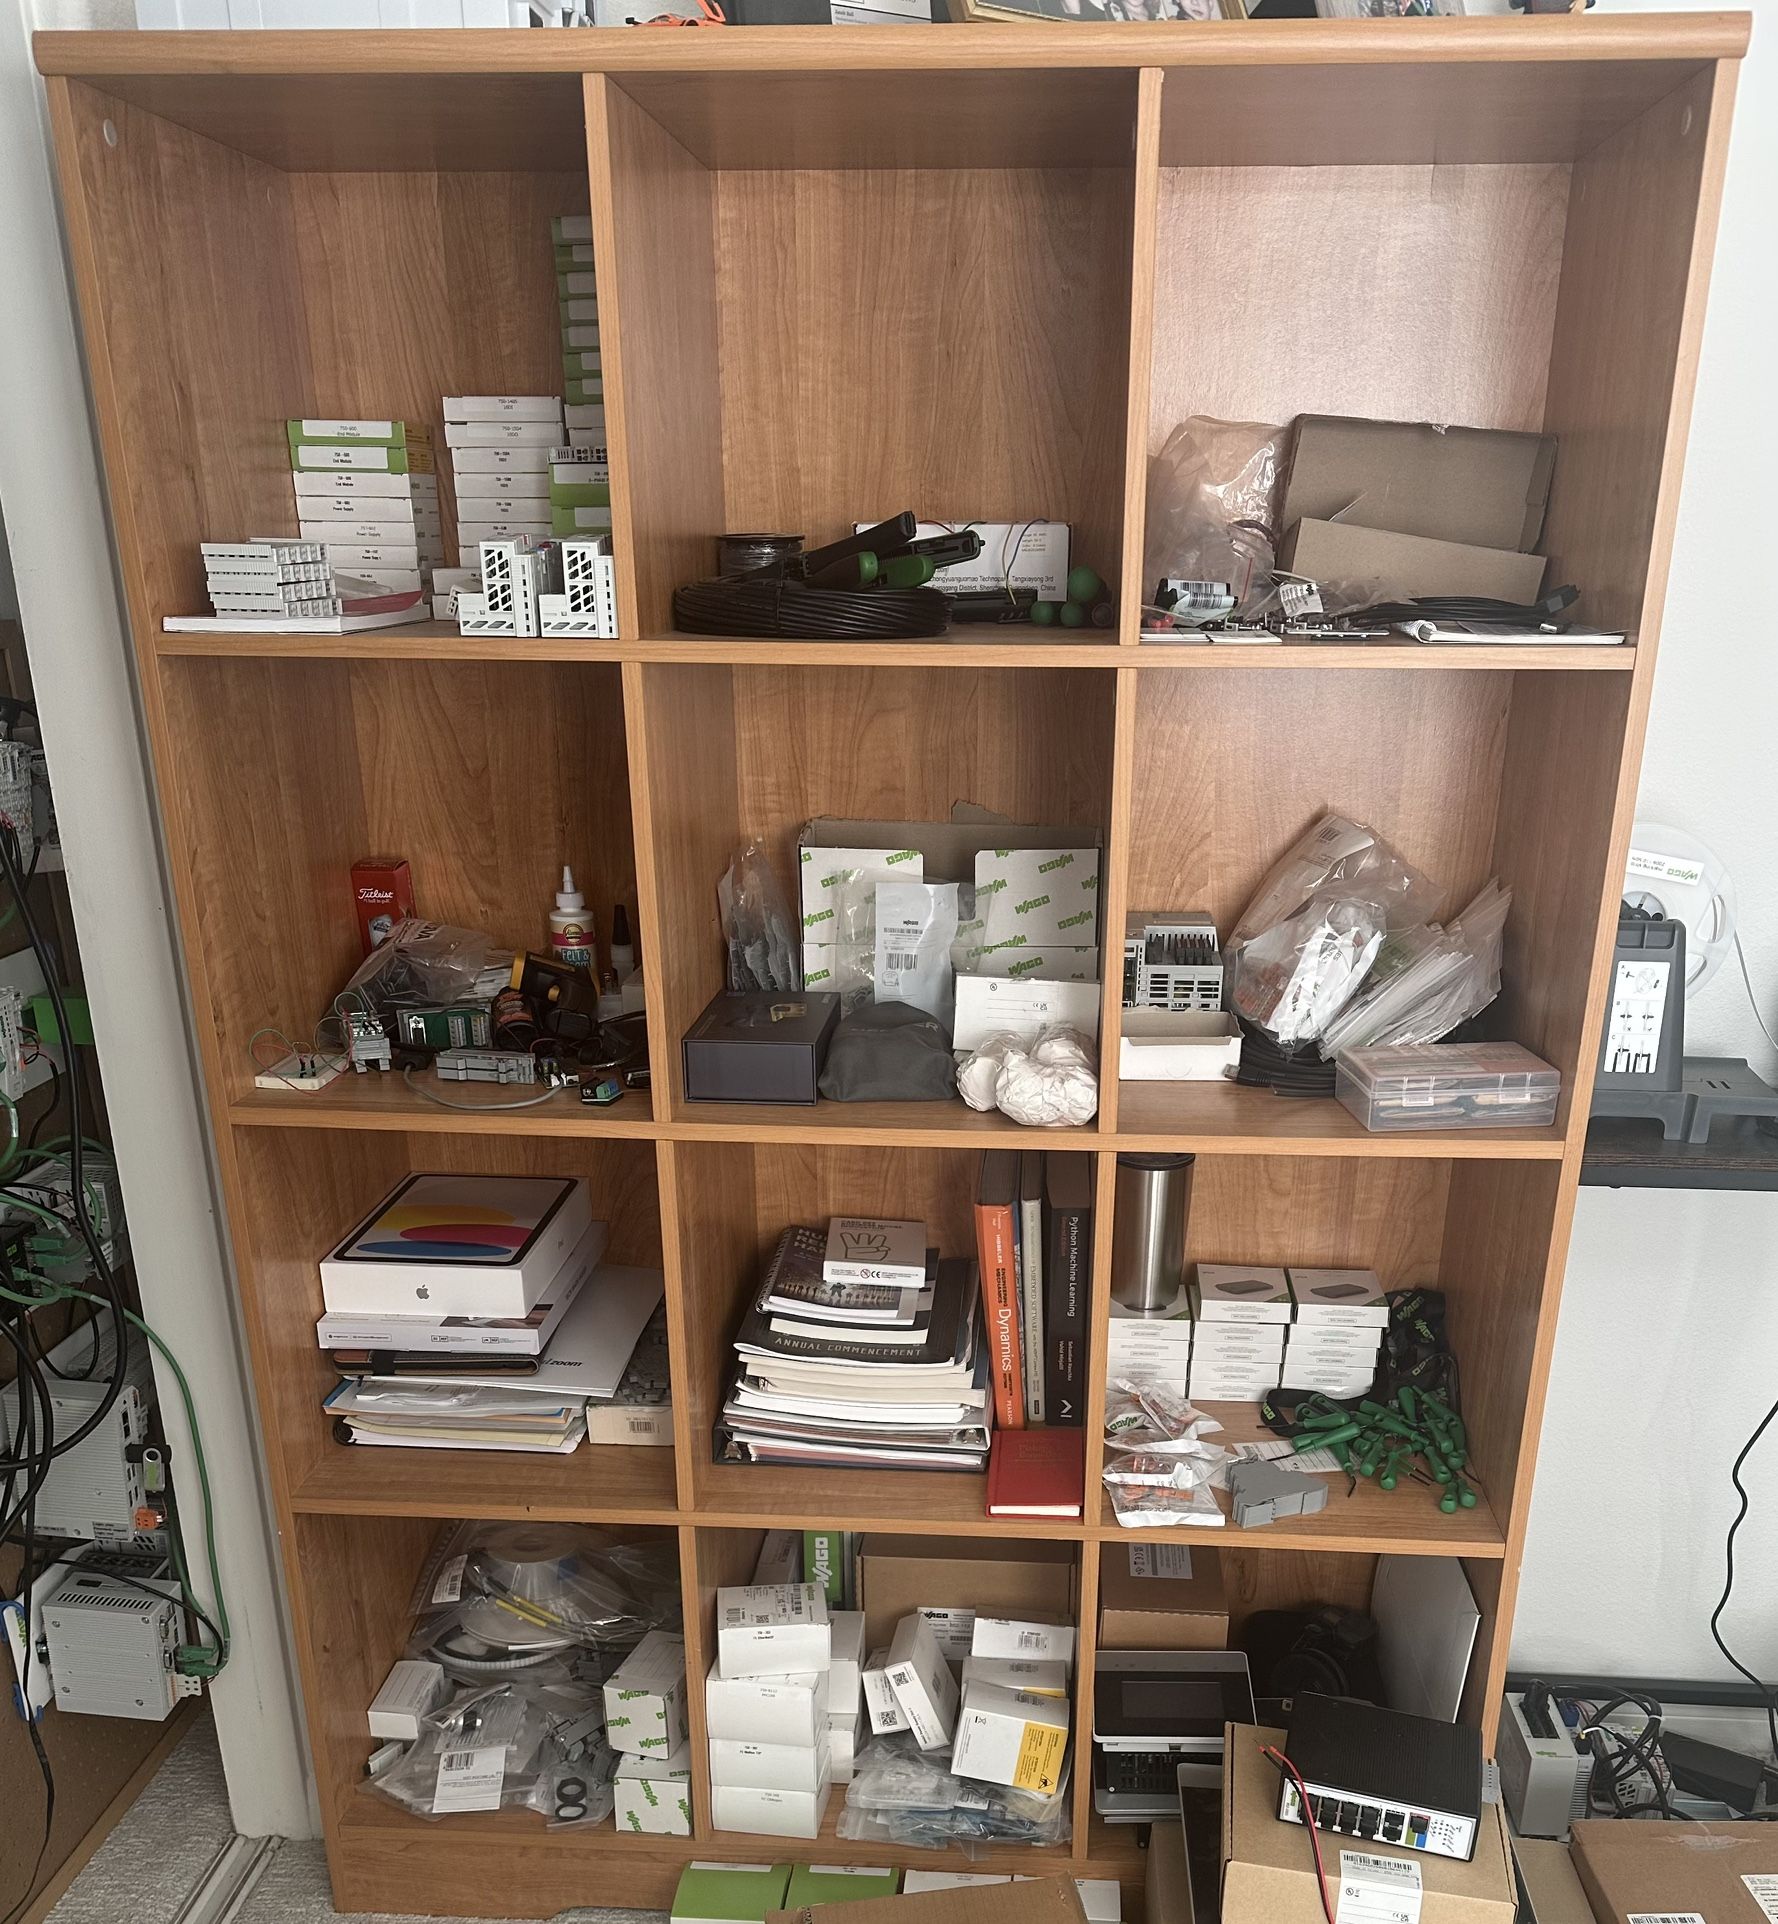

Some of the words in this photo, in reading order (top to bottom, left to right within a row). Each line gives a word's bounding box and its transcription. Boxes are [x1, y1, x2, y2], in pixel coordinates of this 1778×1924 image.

[1038, 853, 1074, 874] WAGO
[1667, 867, 1699, 880] WAGO
[358, 888, 394, 899] Titleist
[1015, 895, 1051, 914] WAGO
[1057, 910, 1093, 930] WAGO
[1008, 956, 1043, 975] WAGO
[804, 969, 831, 987] AGO
[1069, 1216, 1079, 1246] Python
[1069, 1247, 1078, 1281] Machine
[1067, 1283, 1077, 1317] Learning
[775, 1337, 821, 1350] ANNUAL
[827, 1344, 921, 1357] COMMENCEMENT
[996, 1309, 1014, 1371] Dynamics
[1006, 1400, 1014, 1425] PEARSON
[812, 1537, 833, 1588] WAGO
[924, 1611, 949, 1619] WAGO
[617, 1689, 649, 1701] WAGO
[639, 1736, 669, 1749] WAGO
[626, 1810, 642, 1832] WAG
